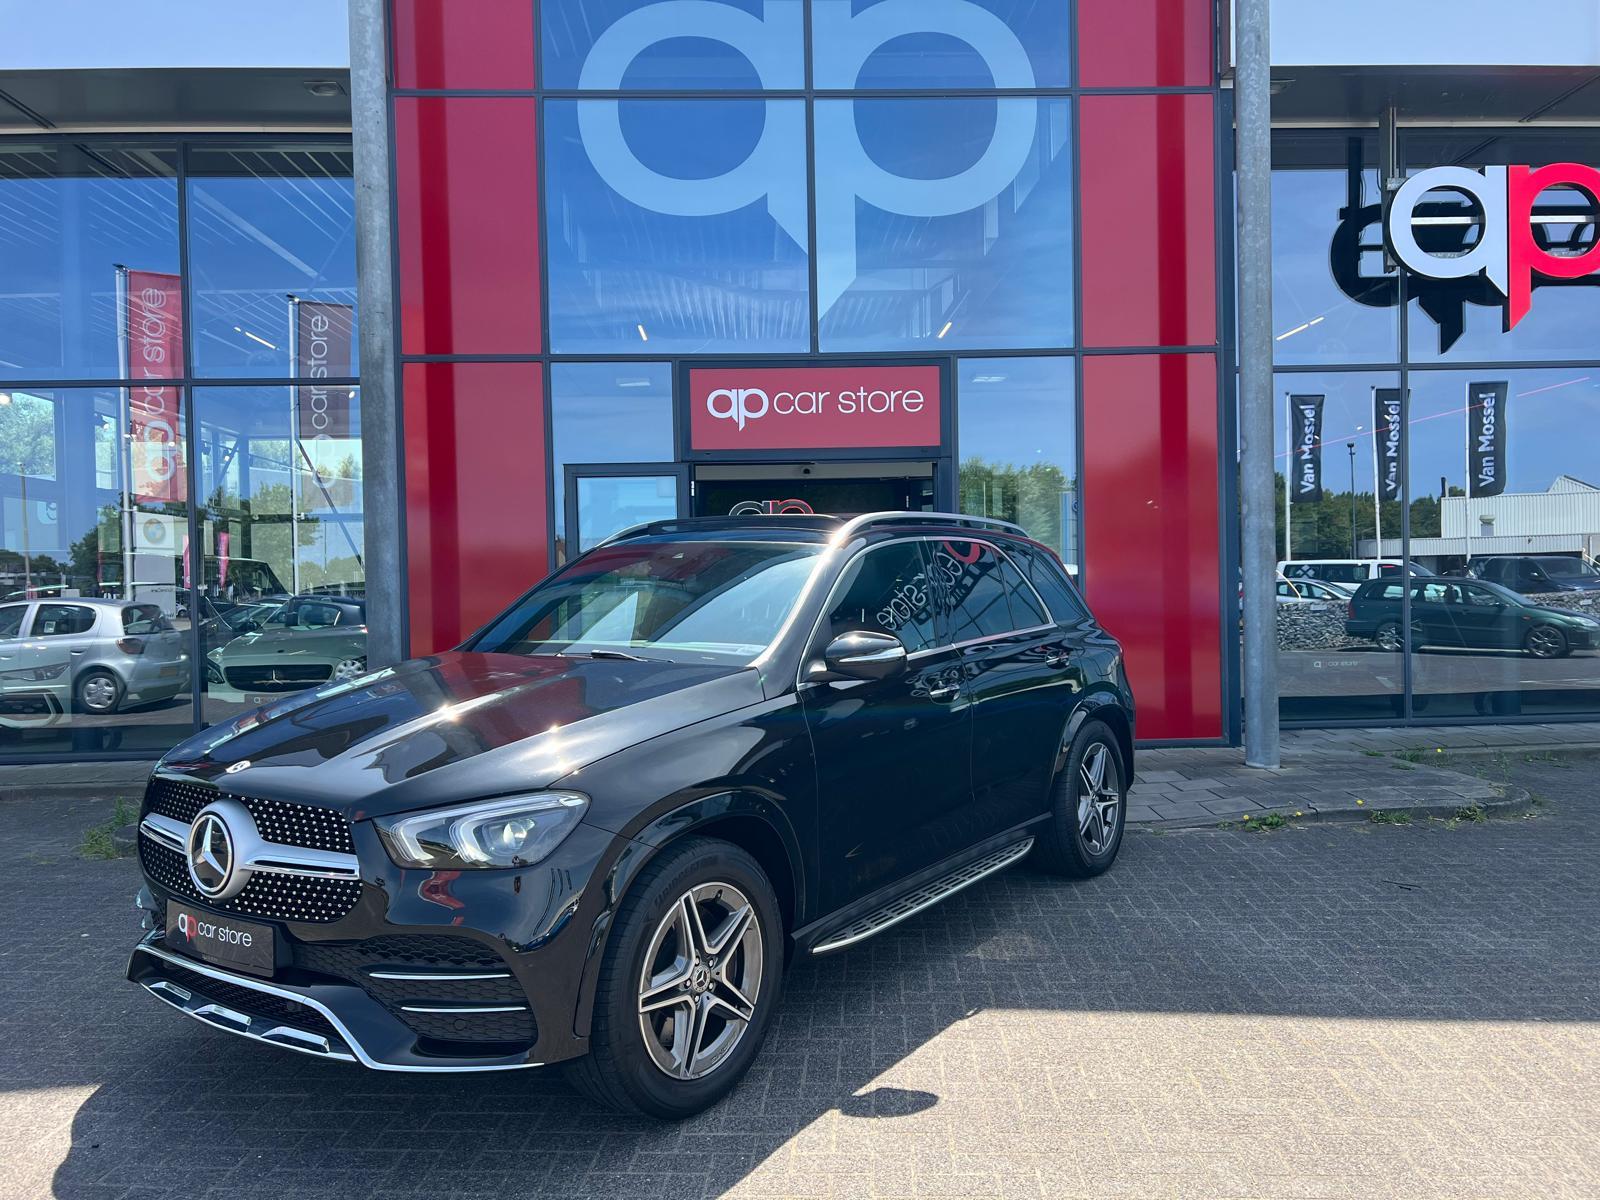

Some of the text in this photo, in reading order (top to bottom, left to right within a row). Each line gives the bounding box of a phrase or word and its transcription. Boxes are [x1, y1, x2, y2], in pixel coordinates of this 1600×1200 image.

[142, 287, 167, 363] store
[307, 315, 328, 378] store
[773, 391, 830, 415] car
[838, 386, 924, 414] store
[1299, 404, 1316, 494] Van Mossel
[1383, 400, 1400, 492] Van Mossel
[1477, 391, 1496, 488] Van Mossel
[198, 921, 216, 938] car
[218, 926, 252, 947] store
